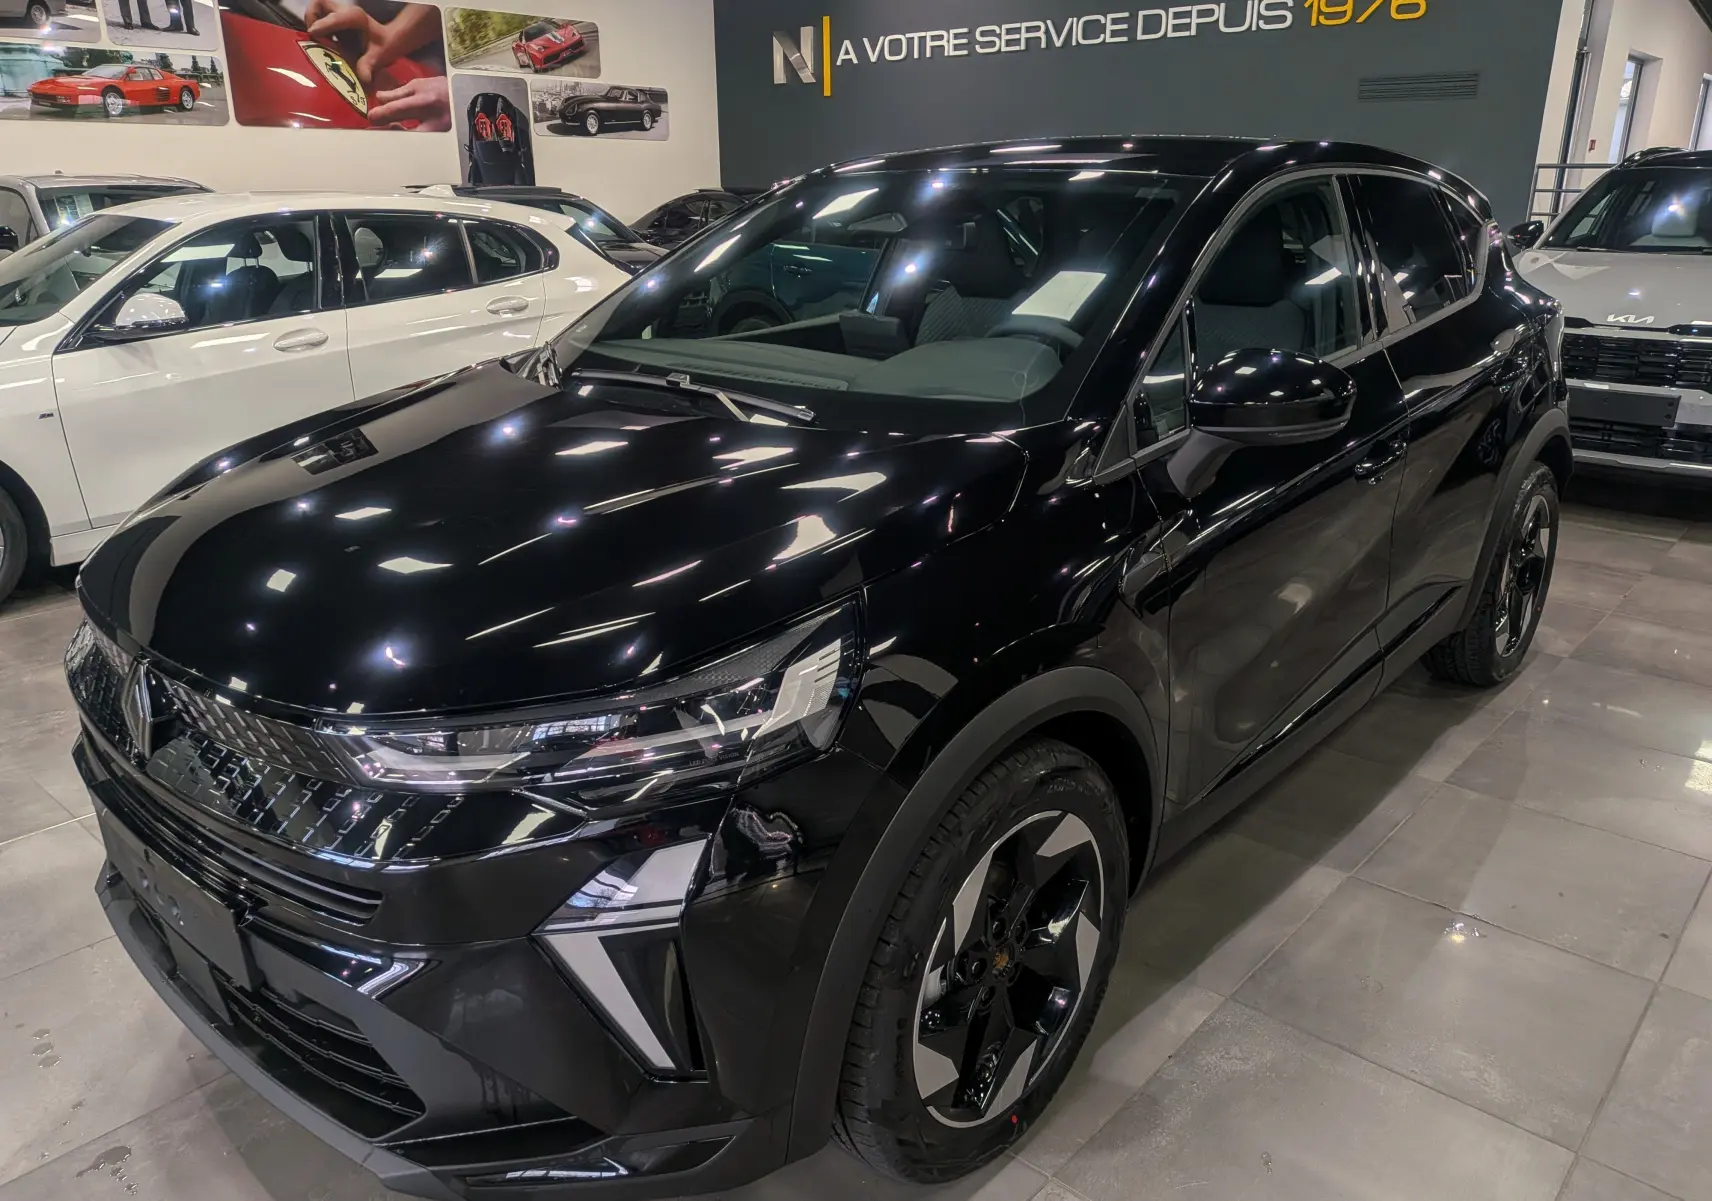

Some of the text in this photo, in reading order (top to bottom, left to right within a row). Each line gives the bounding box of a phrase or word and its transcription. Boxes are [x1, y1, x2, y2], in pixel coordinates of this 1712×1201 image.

[772, 26, 816, 84] N
[836, 39, 859, 66] A
[862, 28, 969, 63] VOTRE
[975, 12, 1130, 53] SERVICE
[1137, 0, 1294, 40] DEPUIS
